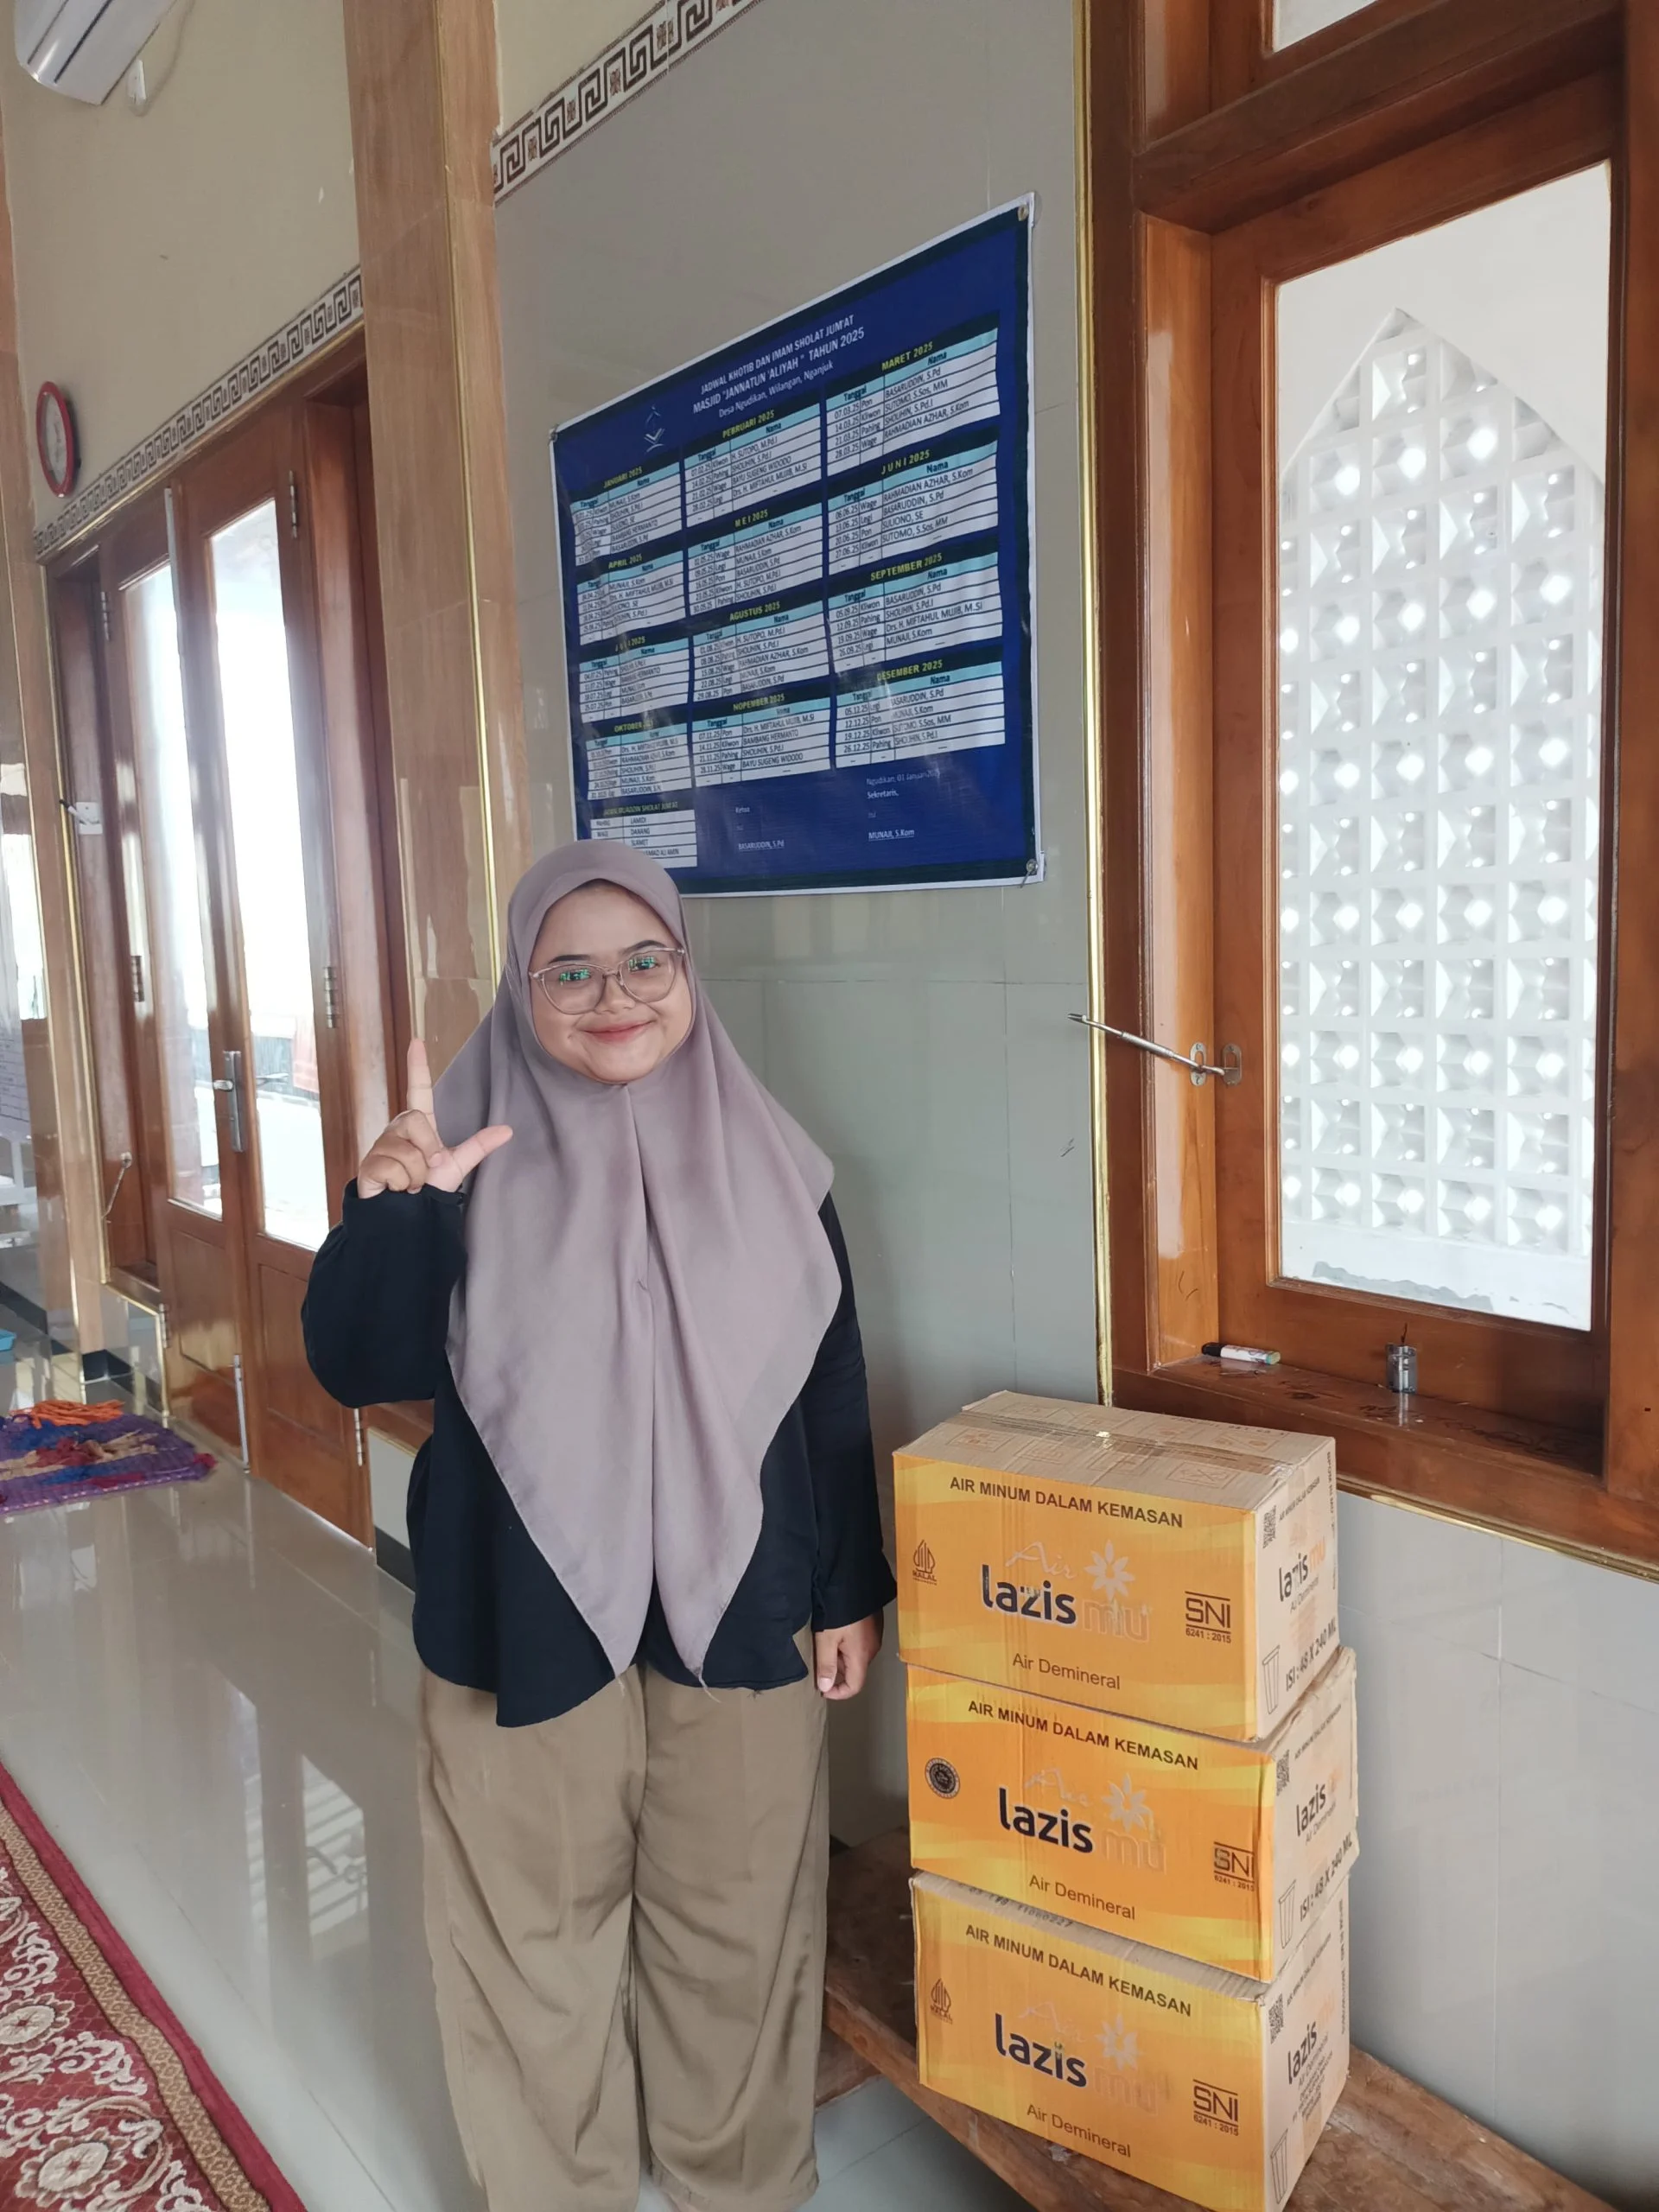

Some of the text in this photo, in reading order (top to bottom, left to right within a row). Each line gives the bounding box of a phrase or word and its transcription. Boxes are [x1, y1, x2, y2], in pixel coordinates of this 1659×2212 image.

[701, 315, 855, 395] JADWAL KHOTIB DAN IMAM SHOLAT JUM'AT
[881, 341, 933, 371] MARET 2025
[927, 352, 947, 365] Nama
[693, 392, 721, 414] MASJID
[809, 341, 838, 361] TAHUN
[840, 327, 864, 347] 2025
[719, 404, 734, 418] Desa
[804, 360, 834, 380] Nganjuk
[834, 403, 860, 420] 07.03.25
[836, 416, 860, 433] 14.03.25
[933, 379, 948, 391] MM
[757, 410, 774, 423] 2025
[861, 435, 878, 449] Wage
[908, 449, 931, 466] 2025
[926, 461, 949, 474] Nama
[753, 509, 768, 521] 2025
[861, 499, 877, 512] Wage
[915, 511, 924, 520] SE
[934, 517, 949, 529] MM
[870, 552, 943, 581] SEPTEMBER 2025
[927, 568, 948, 580] Nama
[730, 607, 763, 621] AGUSTUS
[912, 627, 932, 639] S.Kom
[877, 659, 943, 682] DESEMBER 2025
[931, 674, 950, 685] Nama
[914, 705, 933, 715] S.Kom
[937, 715, 951, 724] MM
[950, 1476, 1183, 1529] AIR MINUM DALAM KEMASAN
[1185, 1597, 1231, 1629] SNI
[1185, 1627, 1231, 1644] 6241 2015
[1013, 1653, 1121, 1690] Air Demineral
[968, 1700, 1198, 1770] AIR MINUM DALAM KEMASAN
[1213, 1847, 1255, 1879] SNI
[1029, 1874, 1136, 1921] Air Demineral
[965, 1923, 1192, 2017] AIR MINUM DALAM KEMASAN
[1192, 2082, 1238, 2123] SNI
[1027, 2103, 1131, 2158] Air Demineral
[1193, 2113, 1239, 2137] 6241 2015
